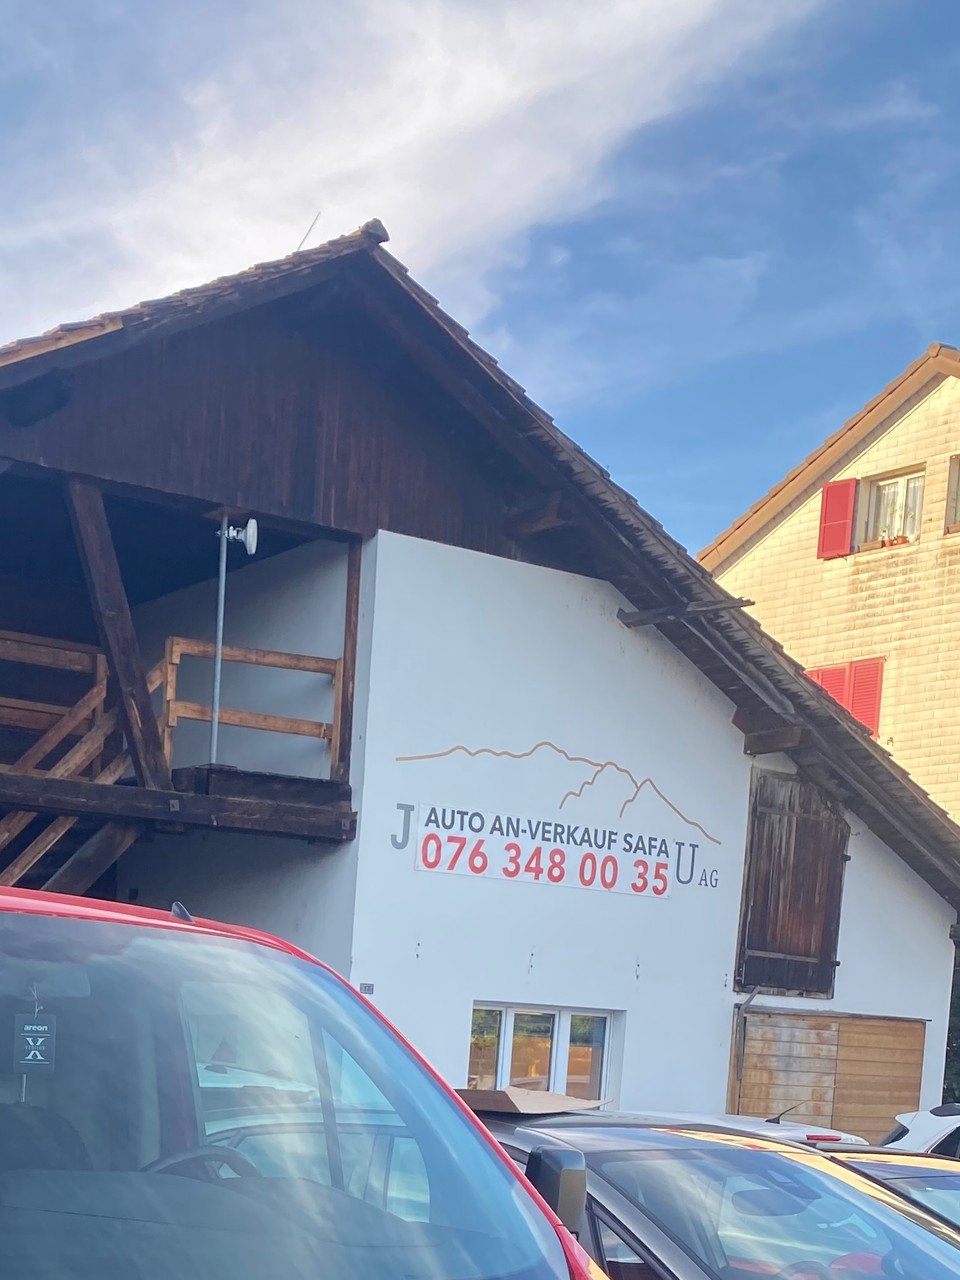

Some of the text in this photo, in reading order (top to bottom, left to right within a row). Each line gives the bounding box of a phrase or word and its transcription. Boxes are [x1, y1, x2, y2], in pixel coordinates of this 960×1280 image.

[390, 803, 415, 850] J
[424, 807, 670, 859] AUTO AN-VERKAUF SAFA
[421, 833, 669, 896] 076 348 00 35
[675, 841, 719, 889] U AG
